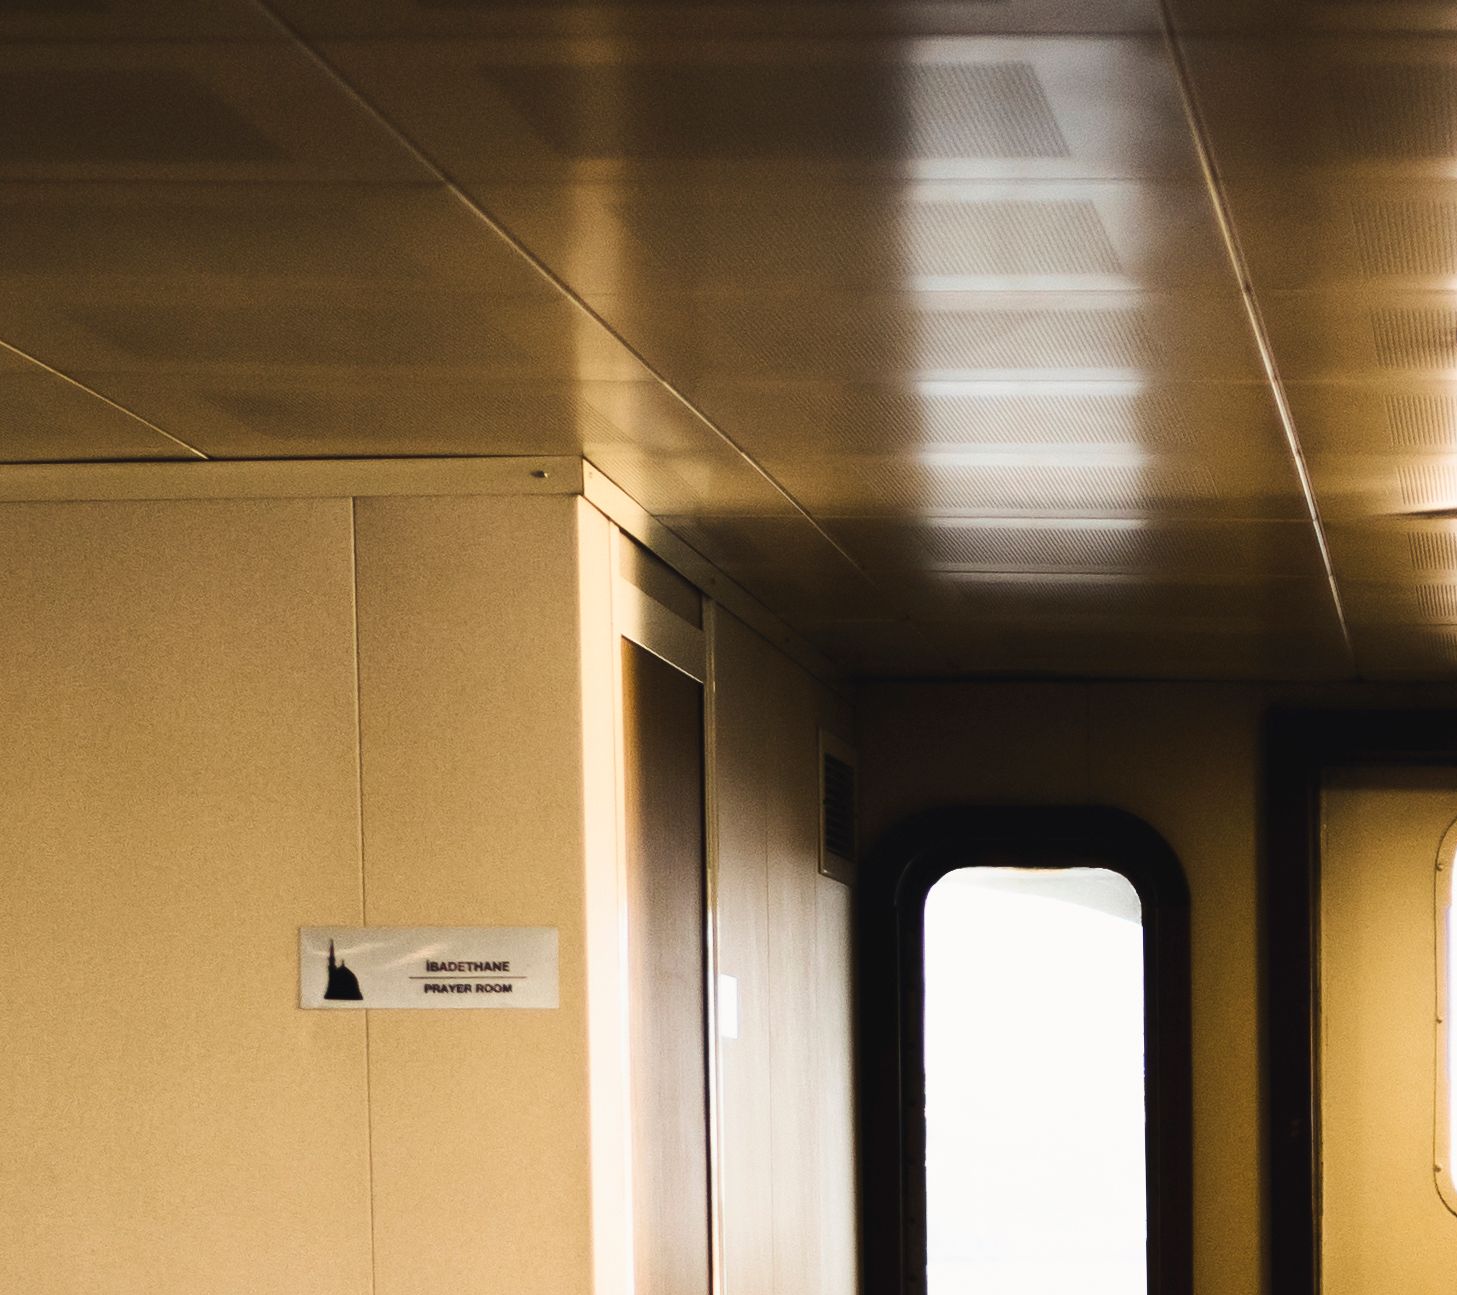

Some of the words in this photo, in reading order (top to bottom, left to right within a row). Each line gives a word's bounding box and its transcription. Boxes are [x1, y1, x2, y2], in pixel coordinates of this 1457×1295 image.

[425, 959, 511, 972] İBADETHANE
[424, 983, 472, 993] PRAYER
[475, 983, 512, 993] ROOM
